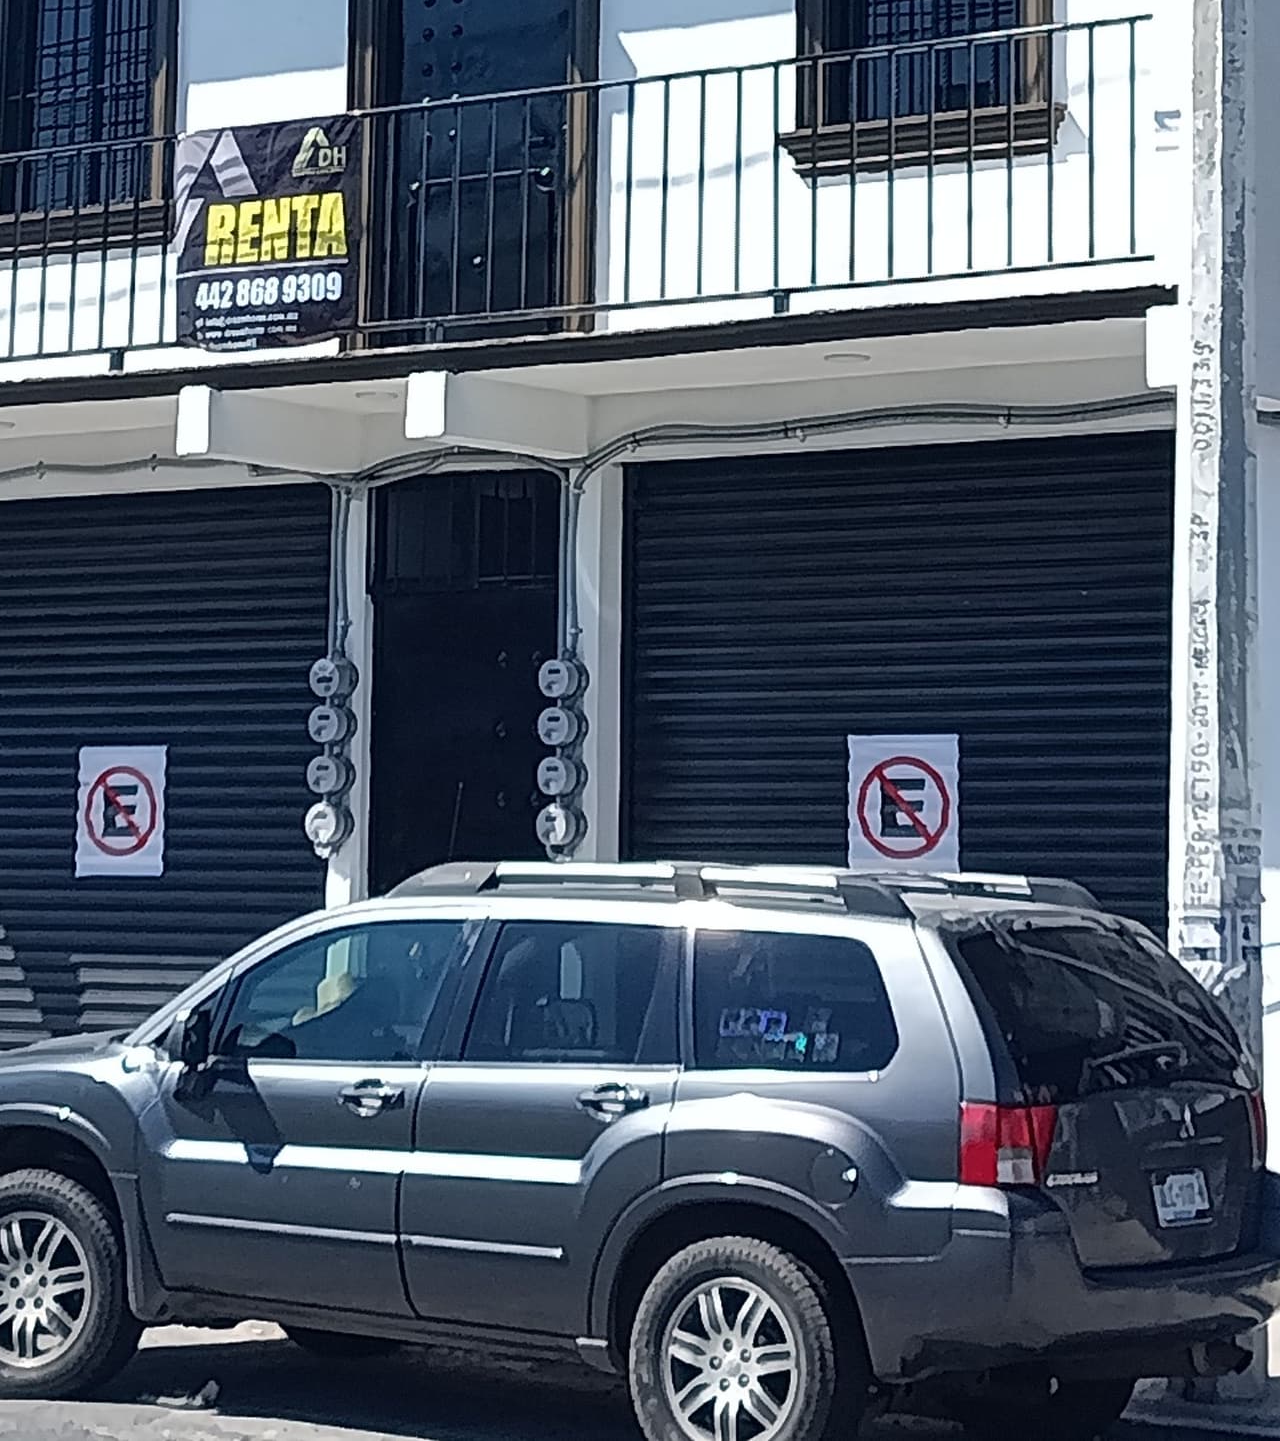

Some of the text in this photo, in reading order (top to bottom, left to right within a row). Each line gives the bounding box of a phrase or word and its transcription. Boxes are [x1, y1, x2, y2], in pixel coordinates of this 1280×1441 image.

[204, 192, 348, 266] RENTA
[195, 271, 342, 310] 442 868 9309
[101, 784, 139, 838] E
[880, 778, 926, 838] E
